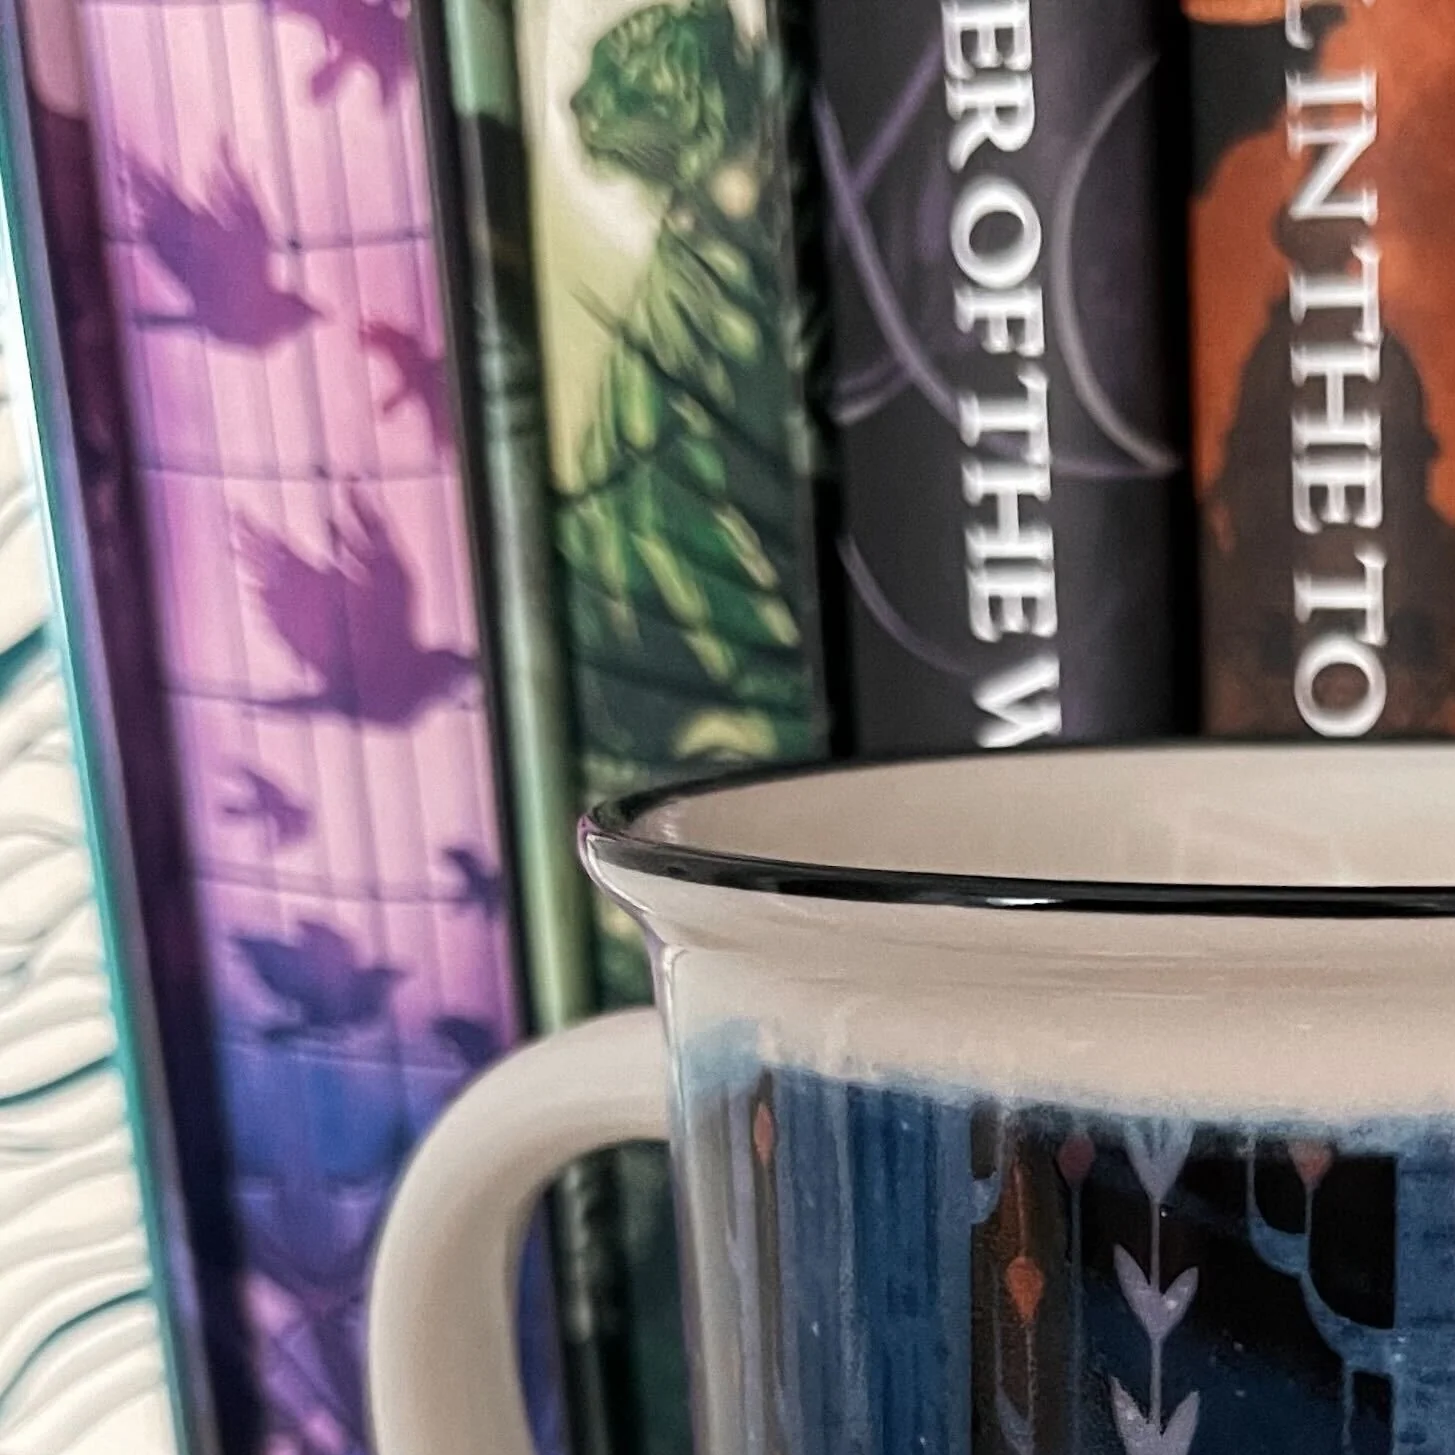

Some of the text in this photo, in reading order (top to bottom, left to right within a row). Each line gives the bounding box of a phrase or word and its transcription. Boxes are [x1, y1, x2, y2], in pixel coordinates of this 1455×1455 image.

[1285, 69, 1378, 224] IN
[950, 175, 1045, 357] OF
[1288, 238, 1383, 534] THE
[959, 366, 1058, 643] THE
[1293, 544, 1387, 737] TO
